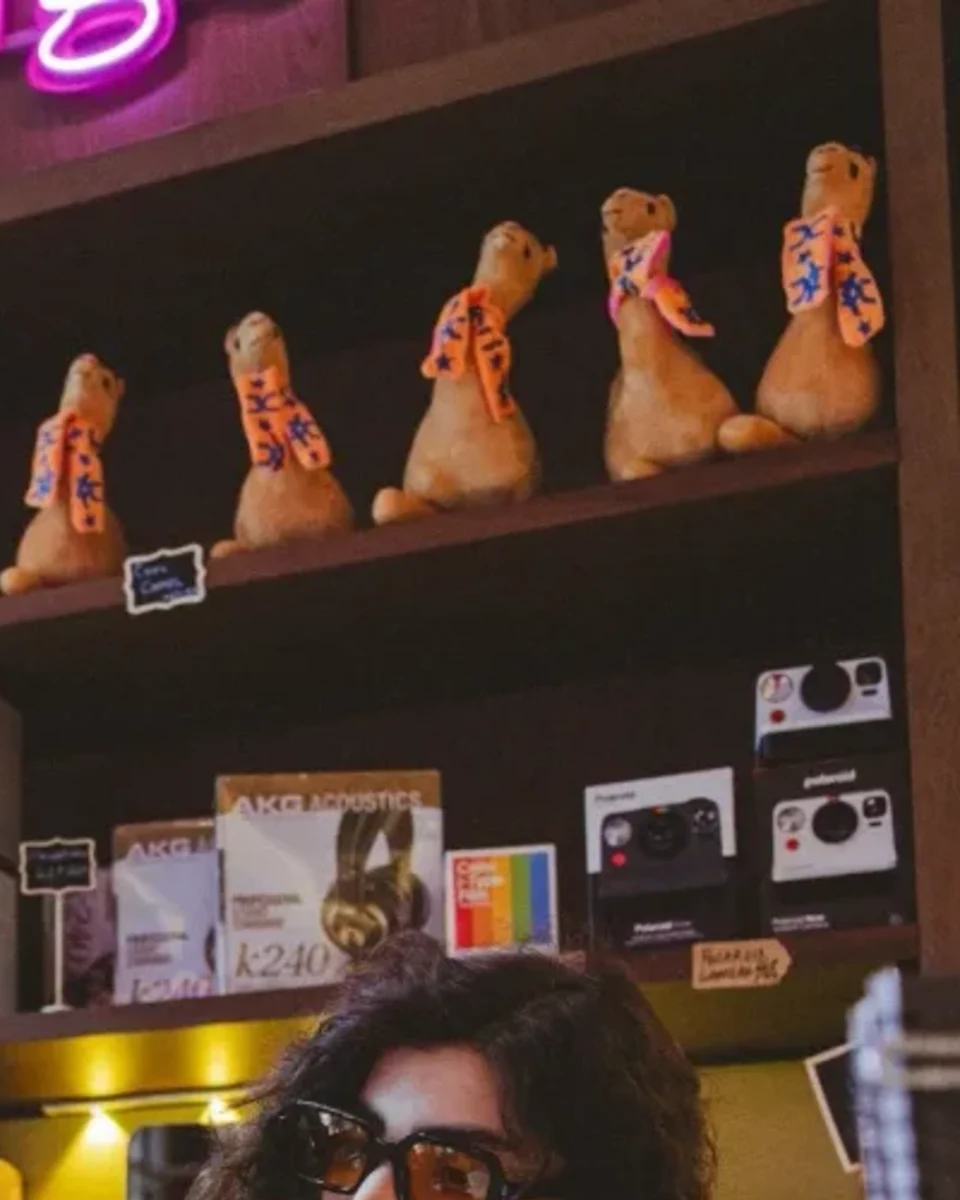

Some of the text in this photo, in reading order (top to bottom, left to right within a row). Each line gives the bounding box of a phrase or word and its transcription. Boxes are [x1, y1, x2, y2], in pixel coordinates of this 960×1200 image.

[233, 790, 423, 815] AKG ACOUSTICS
[128, 837, 193, 862] AKG
